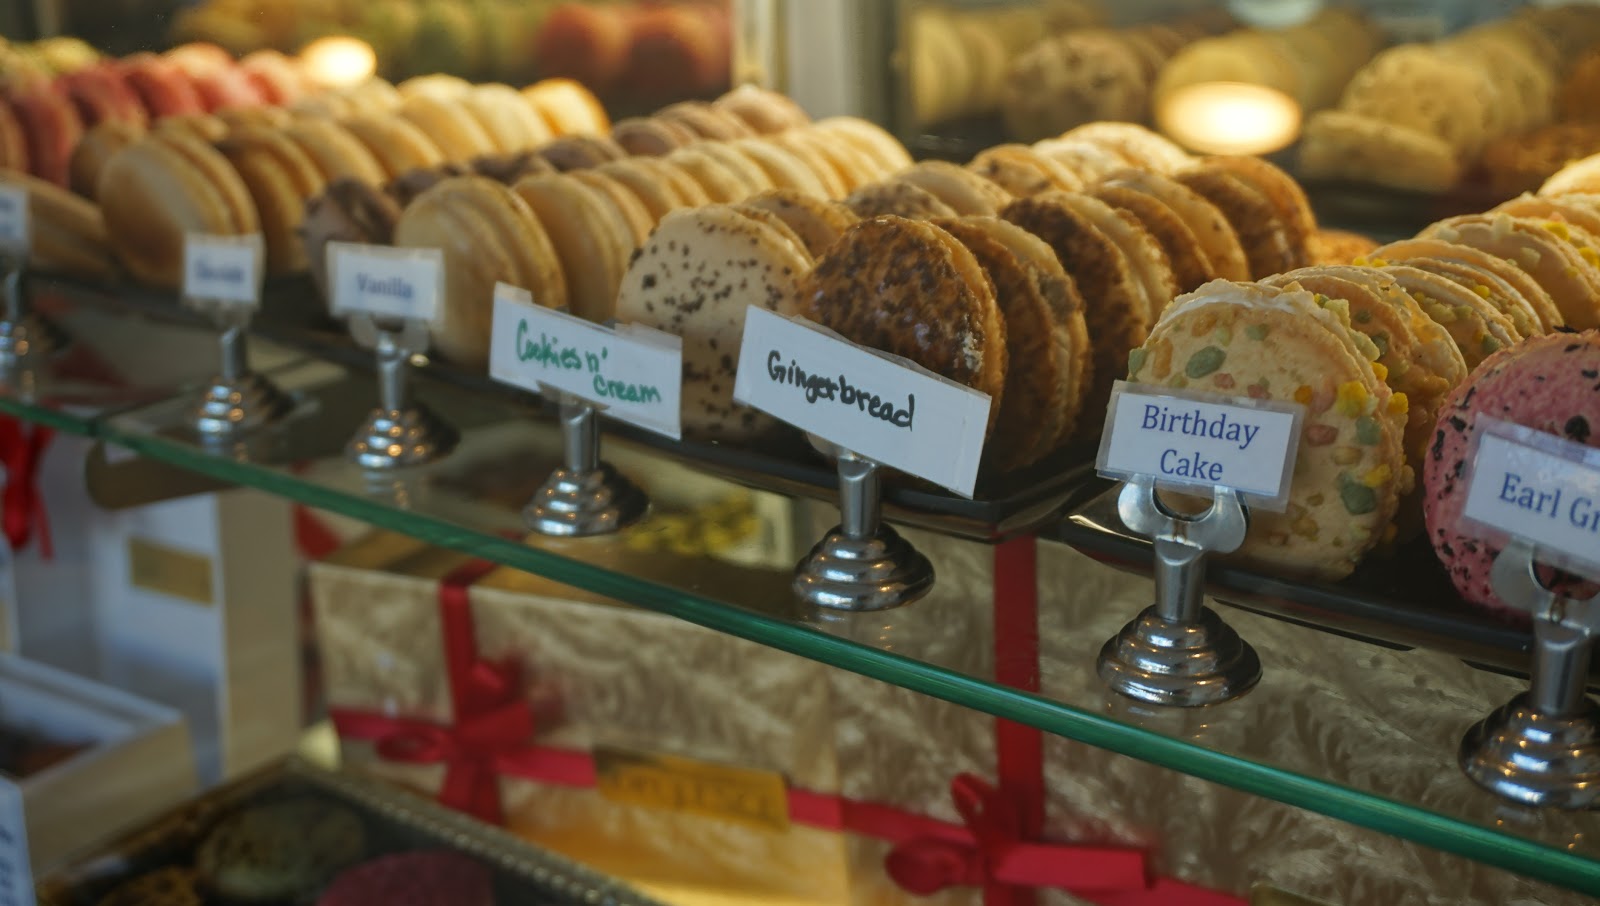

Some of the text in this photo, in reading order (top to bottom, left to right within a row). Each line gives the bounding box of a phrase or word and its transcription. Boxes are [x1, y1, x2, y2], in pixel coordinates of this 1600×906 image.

[356, 271, 412, 299] Vanilla
[516, 318, 583, 370] Cookies
[767, 350, 915, 432] Gingerbread
[1141, 404, 1260, 449] Birthday
[1159, 449, 1223, 481] Cake
[1499, 471, 1562, 519] Earl
